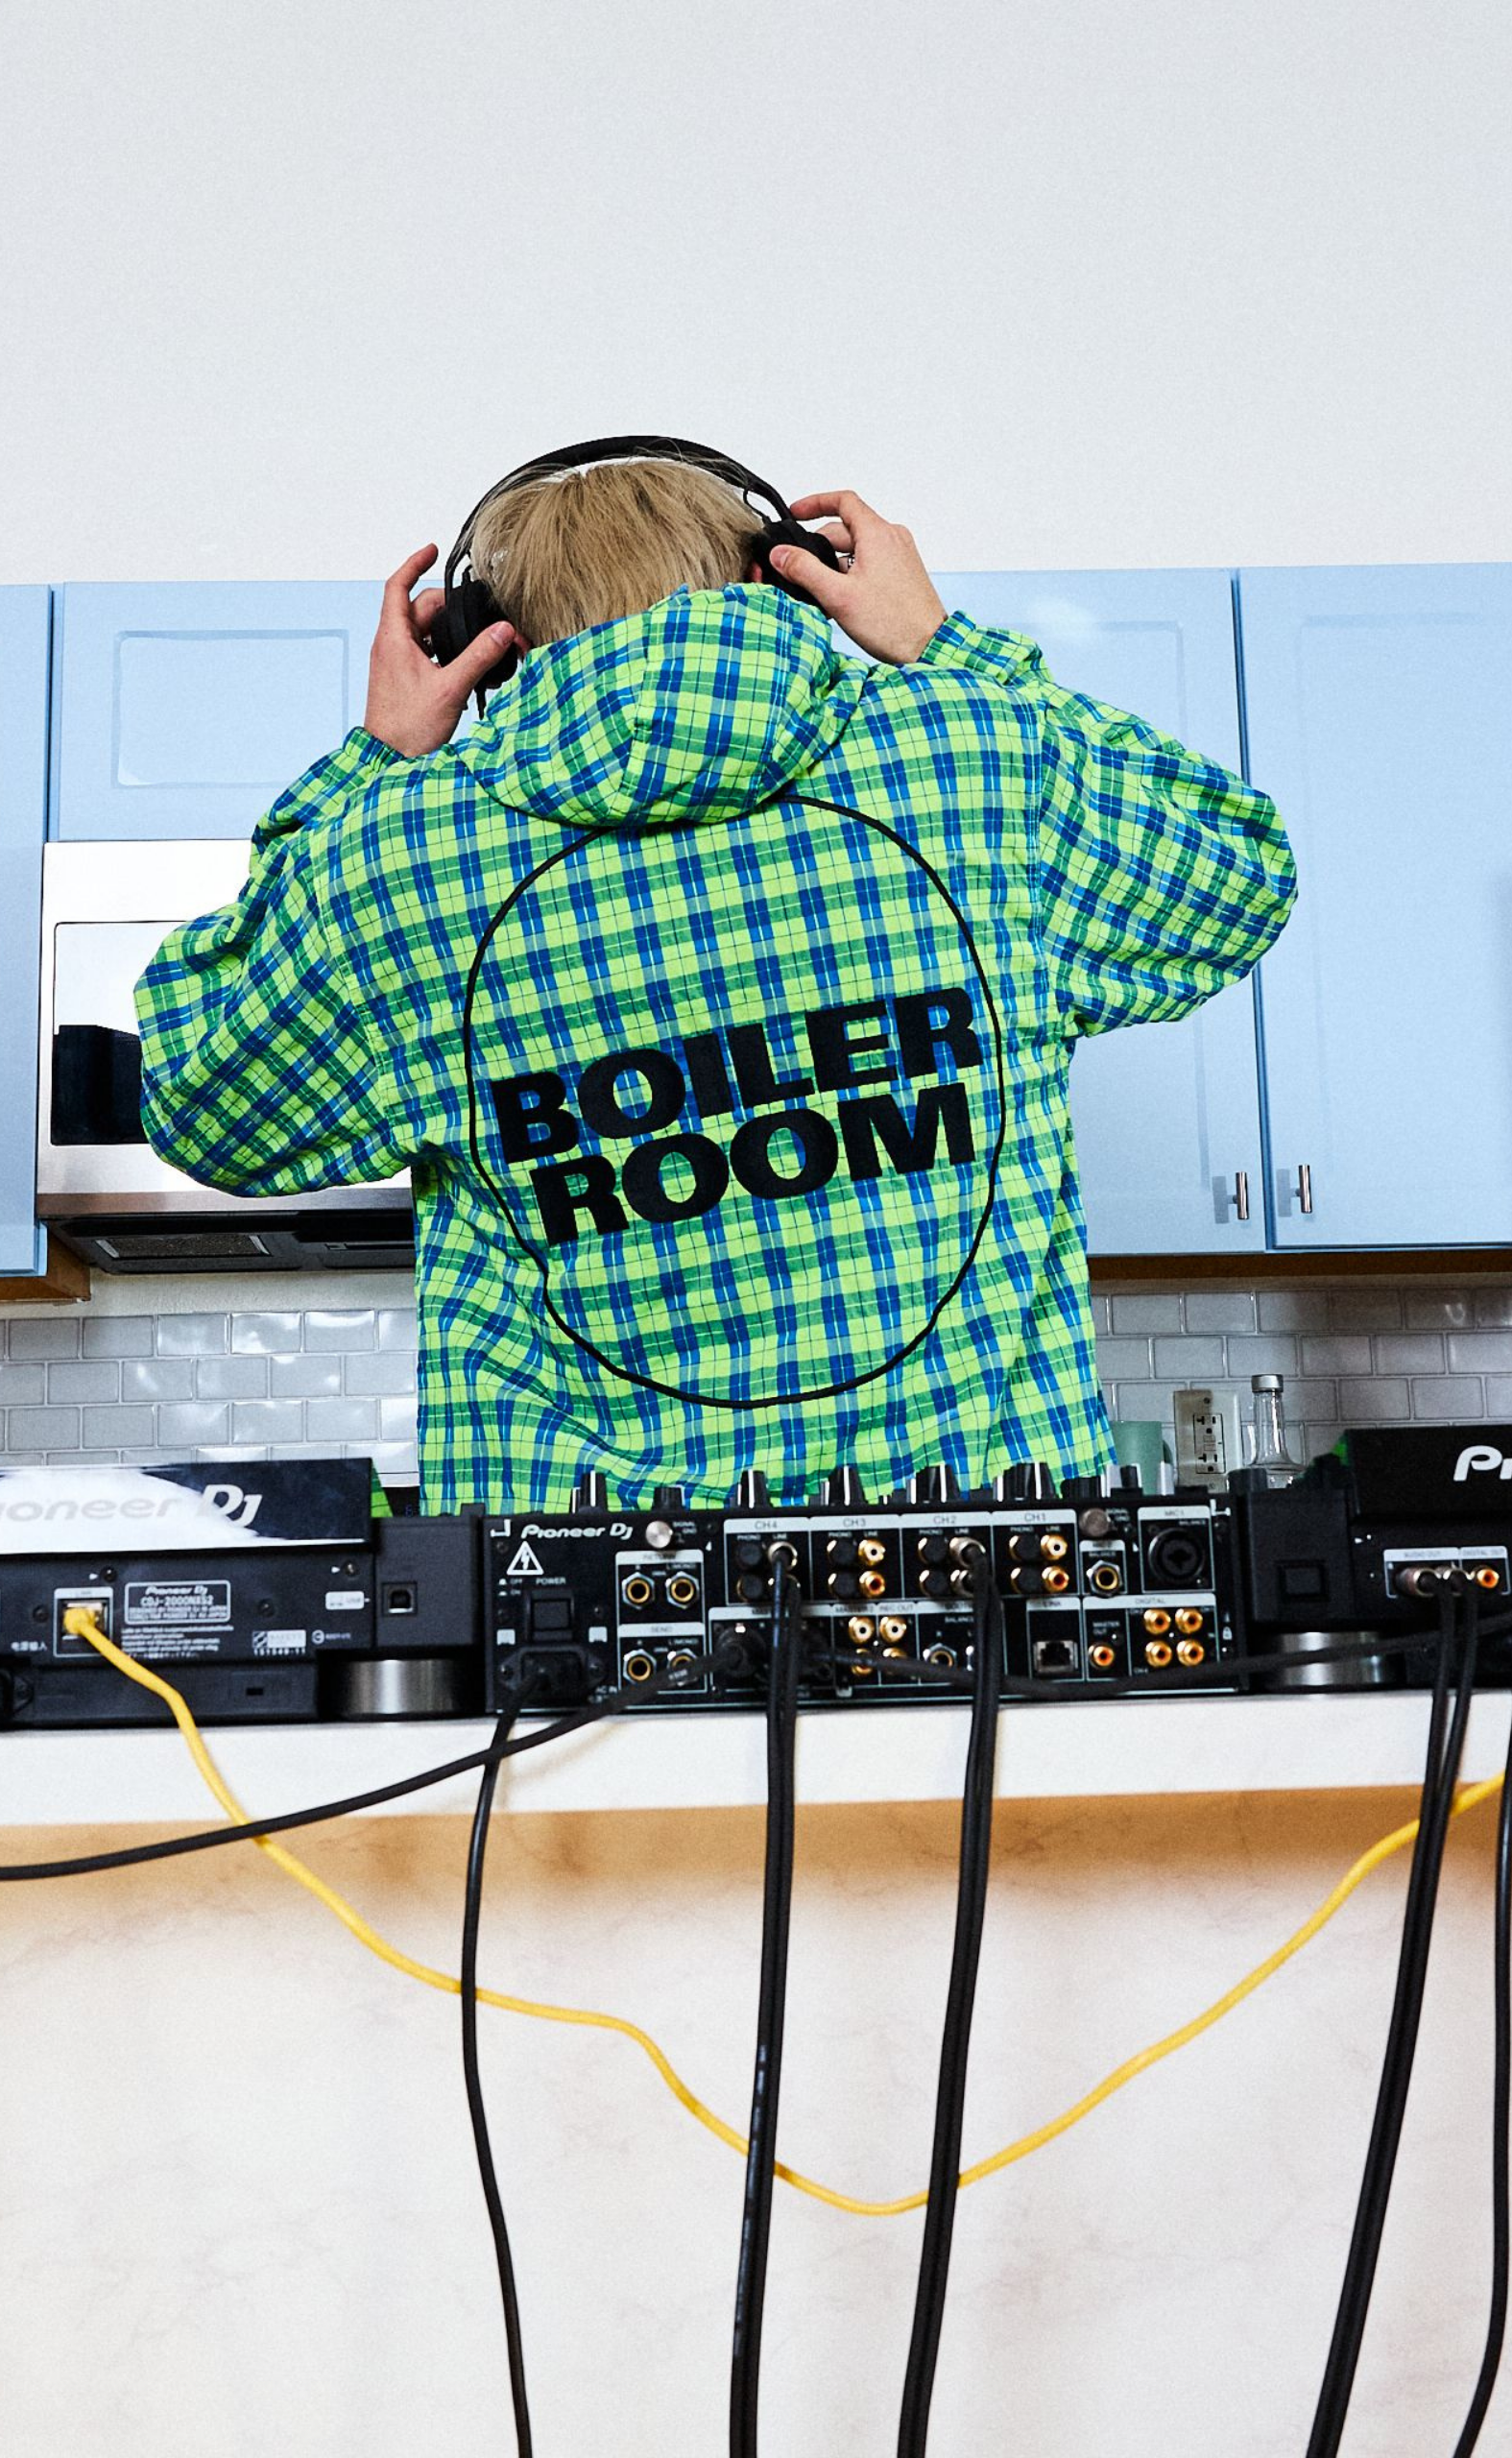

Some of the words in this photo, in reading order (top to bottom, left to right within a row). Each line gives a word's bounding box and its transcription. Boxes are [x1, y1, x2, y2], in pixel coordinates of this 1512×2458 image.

[491, 986, 984, 1163] BOILER
[530, 1082, 975, 1246] ROOM
[0, 1498, 181, 1522] oneer
[198, 1484, 263, 1528] DJ
[521, 1524, 606, 1539] Pioneer
